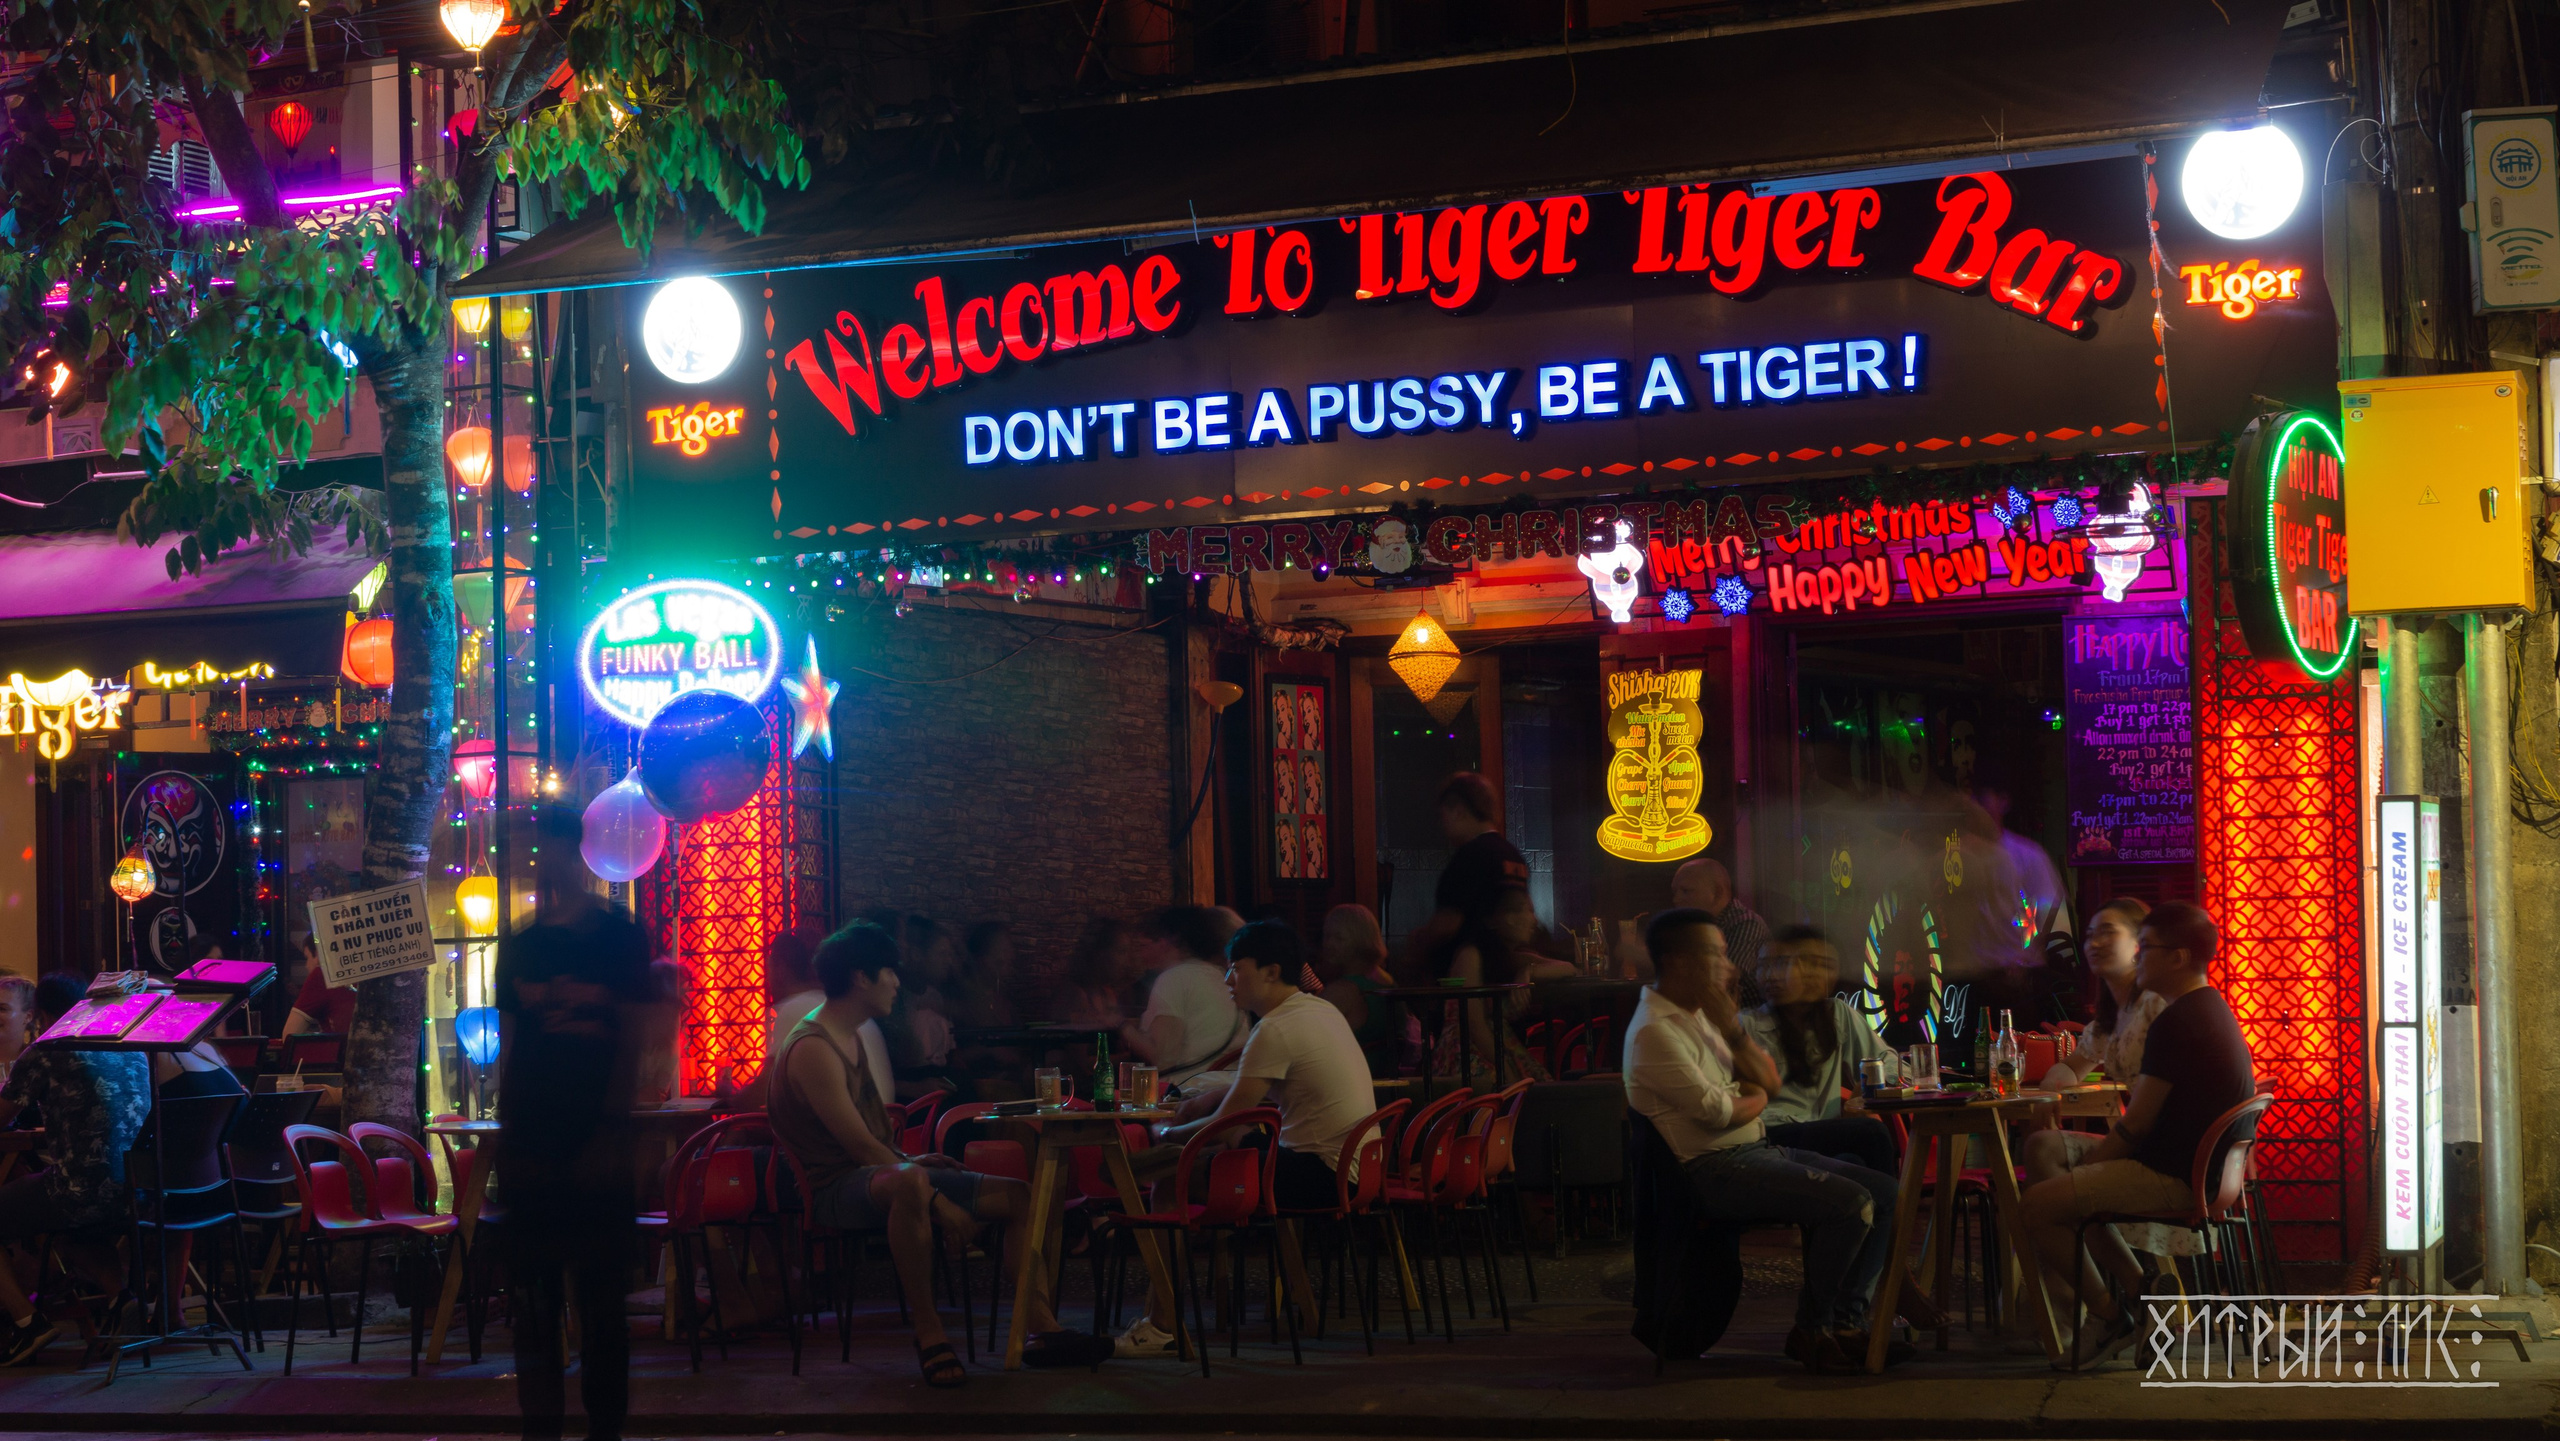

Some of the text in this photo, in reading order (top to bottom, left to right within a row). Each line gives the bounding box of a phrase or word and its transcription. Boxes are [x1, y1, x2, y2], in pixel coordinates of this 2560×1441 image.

[785, 170, 2122, 436] Welcome To Tiger Tiger Bar
[2179, 259, 2302, 320] Tiger
[647, 403, 745, 456] Tiger
[965, 403, 1134, 465] DON'T
[1154, 394, 1230, 450] BE
[1248, 391, 1291, 442] A
[1309, 371, 1521, 436] PUSSY,
[1539, 363, 1619, 417] BE
[1640, 356, 1685, 409] A
[2288, 436, 2338, 501] HỘI AN
[1148, 493, 1796, 575] MERRY CHRISTMAS
[2273, 502, 2348, 583] Tiger Tige
[1768, 534, 2089, 614] Happy New Year
[2296, 585, 2339, 655] BAR
[602, 638, 758, 674] FUNKY BALL
[1608, 670, 1702, 709] Shisha 120K
[216, 706, 297, 732] MERRY
[1667, 734, 1694, 745] melon
[2094, 715, 2123, 731] Buy
[2139, 713, 2160, 729] get
[1617, 763, 1643, 777] Grape
[1617, 778, 1647, 793] Cherry
[1663, 777, 1692, 792] Guava
[1668, 760, 1694, 775] Apple
[2139, 792, 2158, 805] to
[2391, 830, 2408, 912] CREAM
[330, 891, 411, 921] CẦN TUYỂN
[330, 940, 339, 953] 4
[366, 926, 403, 945] PHỤC
[406, 921, 423, 936] VỤ
[398, 939, 421, 953] ANH)
[2392, 918, 2408, 957] ICE
[336, 951, 429, 979] ĐT: 0925913406
[1944, 983, 1970, 1039] DJ
[2394, 980, 2409, 1025] LAN
[2389, 1033, 2410, 1087] THÁI
[2391, 1097, 2413, 1160] CUỘN
[2395, 1168, 2411, 1220] KEM
